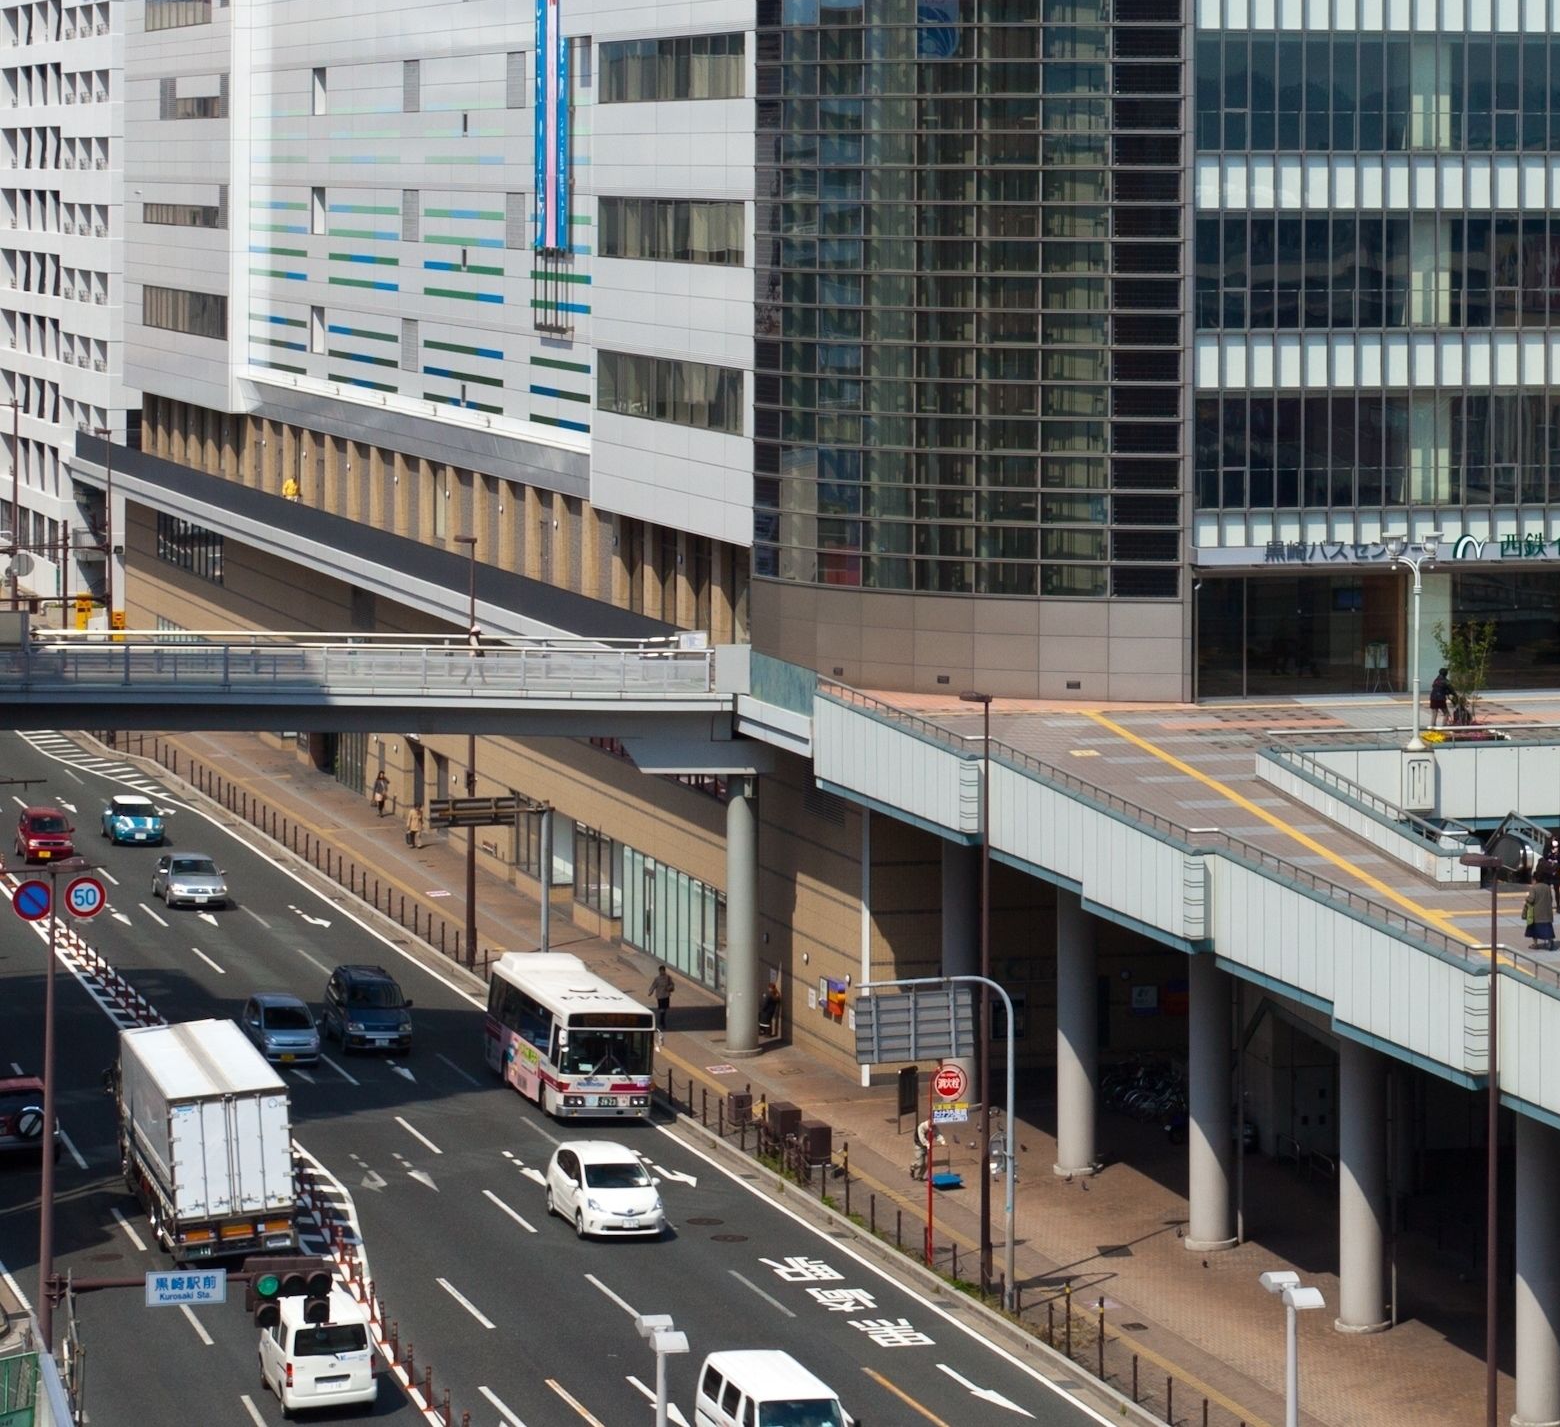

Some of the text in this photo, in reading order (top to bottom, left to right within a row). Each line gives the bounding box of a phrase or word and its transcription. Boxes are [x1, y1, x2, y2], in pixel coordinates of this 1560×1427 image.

[1265, 540, 1424, 562] 黒崎バスセンー
[74, 888, 96, 907] 50
[155, 1276, 217, 1291] 黒崎駅前
[159, 1291, 212, 1300] Kurosaki Sta.
